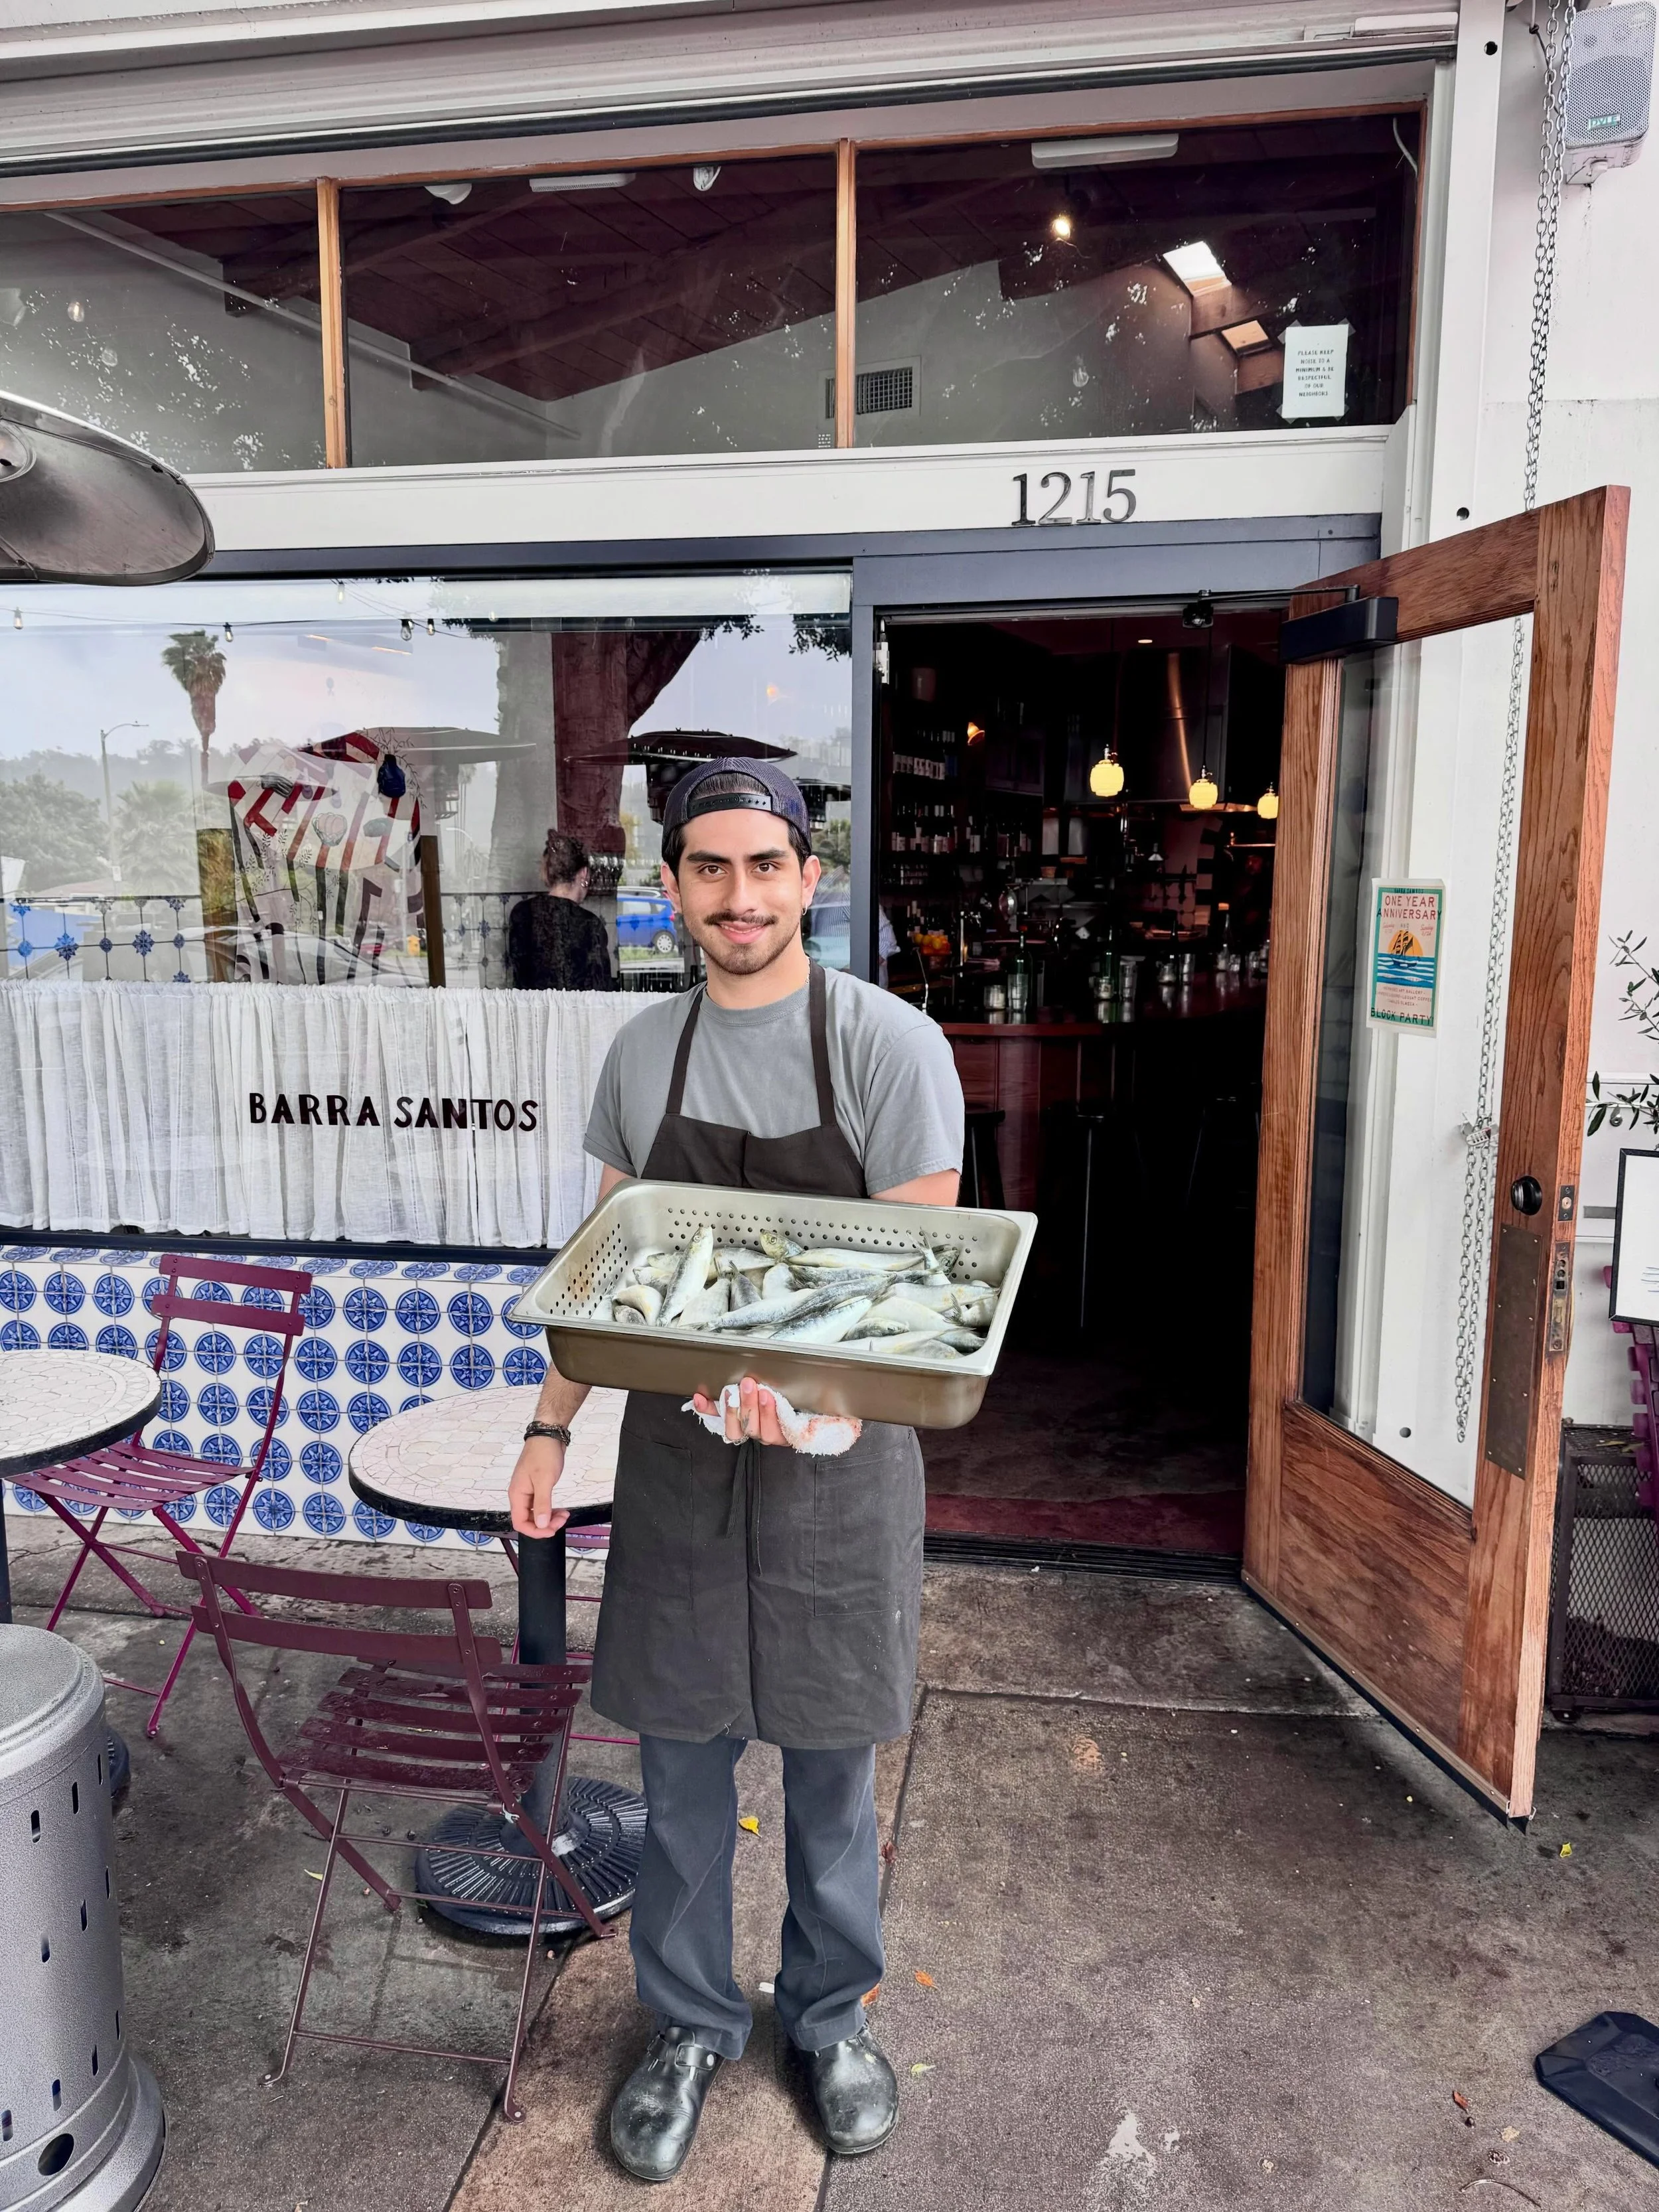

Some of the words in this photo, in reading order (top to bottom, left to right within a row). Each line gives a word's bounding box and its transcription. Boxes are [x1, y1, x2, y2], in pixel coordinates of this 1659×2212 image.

[1011, 469, 1137, 526] 1215
[1385, 895, 1402, 906] ONE
[1406, 896, 1435, 907] YEAR
[1376, 908, 1442, 921] ANNIVERSARY
[1370, 1007, 1396, 1020] BLOCK
[249, 1092, 380, 1127] BARRA
[394, 1096, 539, 1132] SANTOS
